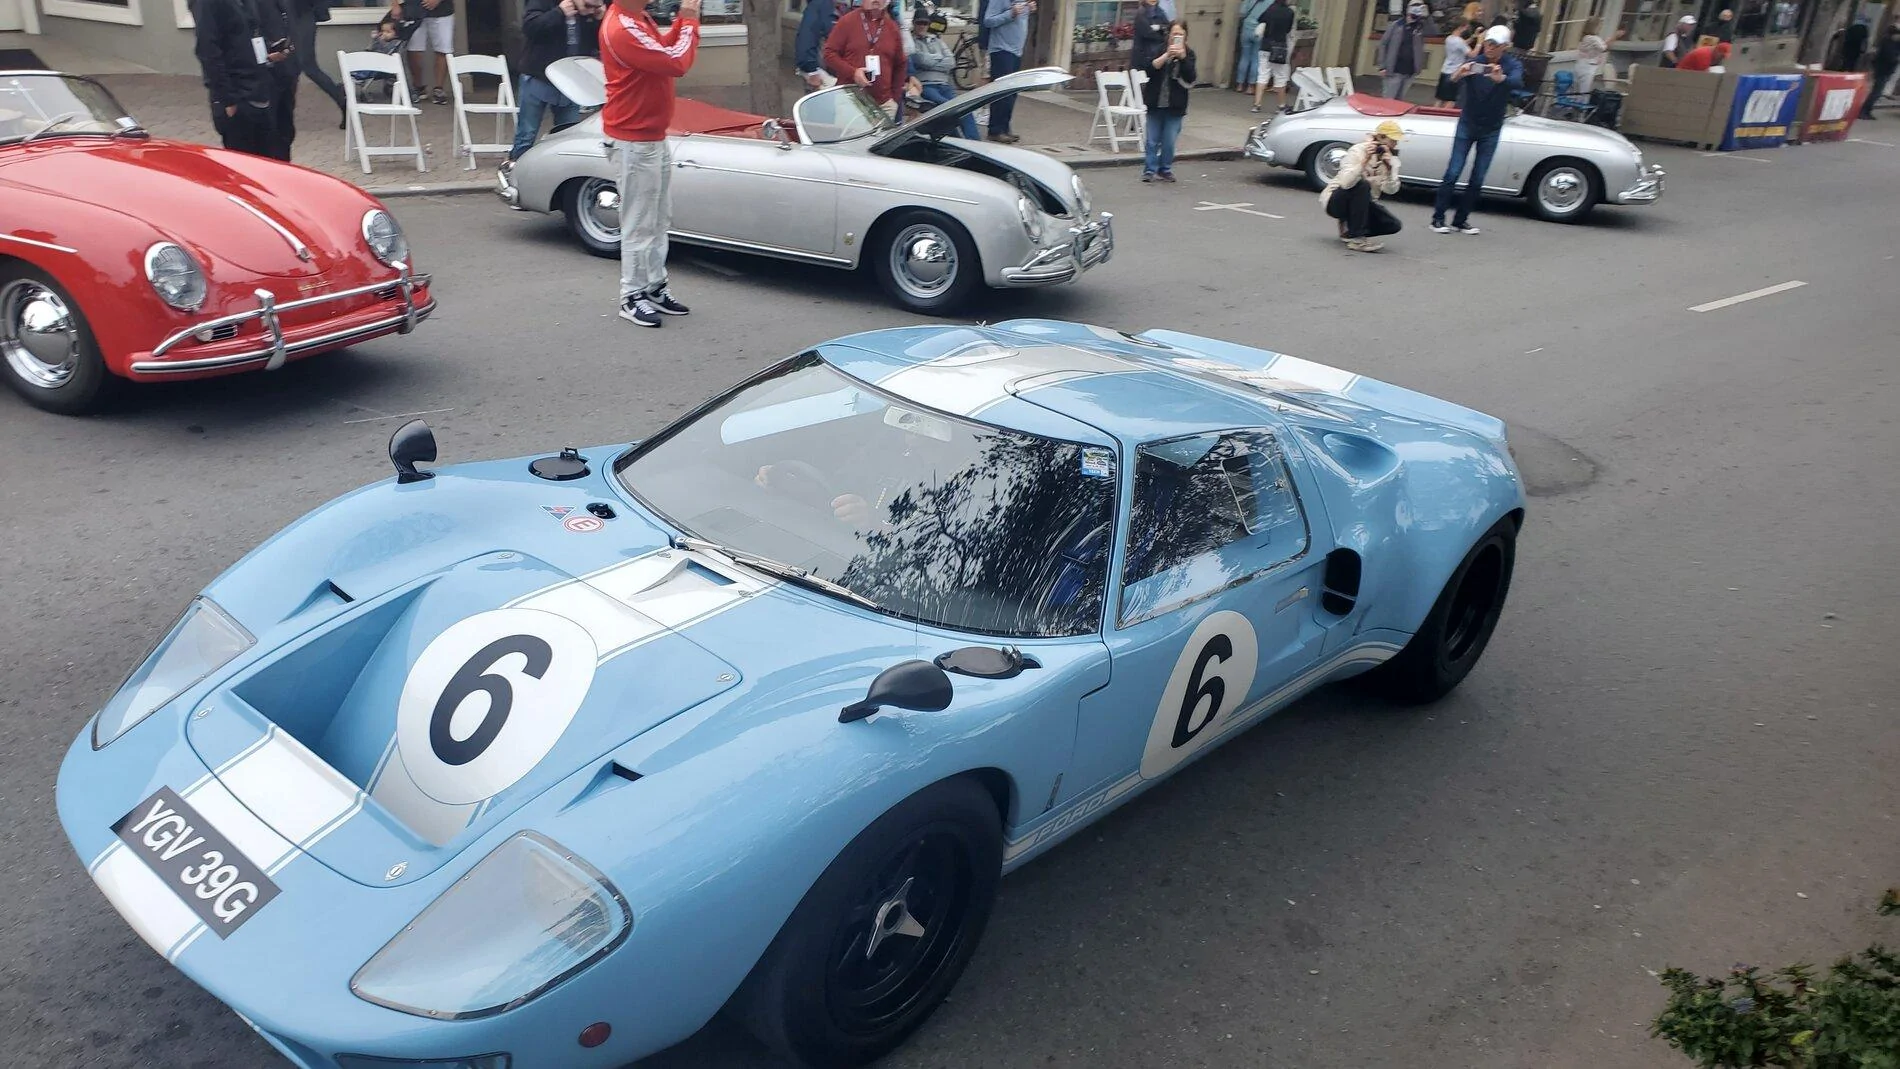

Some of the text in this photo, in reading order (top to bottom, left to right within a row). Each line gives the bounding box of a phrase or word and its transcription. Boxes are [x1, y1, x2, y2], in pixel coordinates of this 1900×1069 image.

[429, 634, 553, 766] 6
[1170, 633, 1233, 749] 6
[131, 798, 259, 924] YGV 39G
[1039, 791, 1106, 839] FORD
